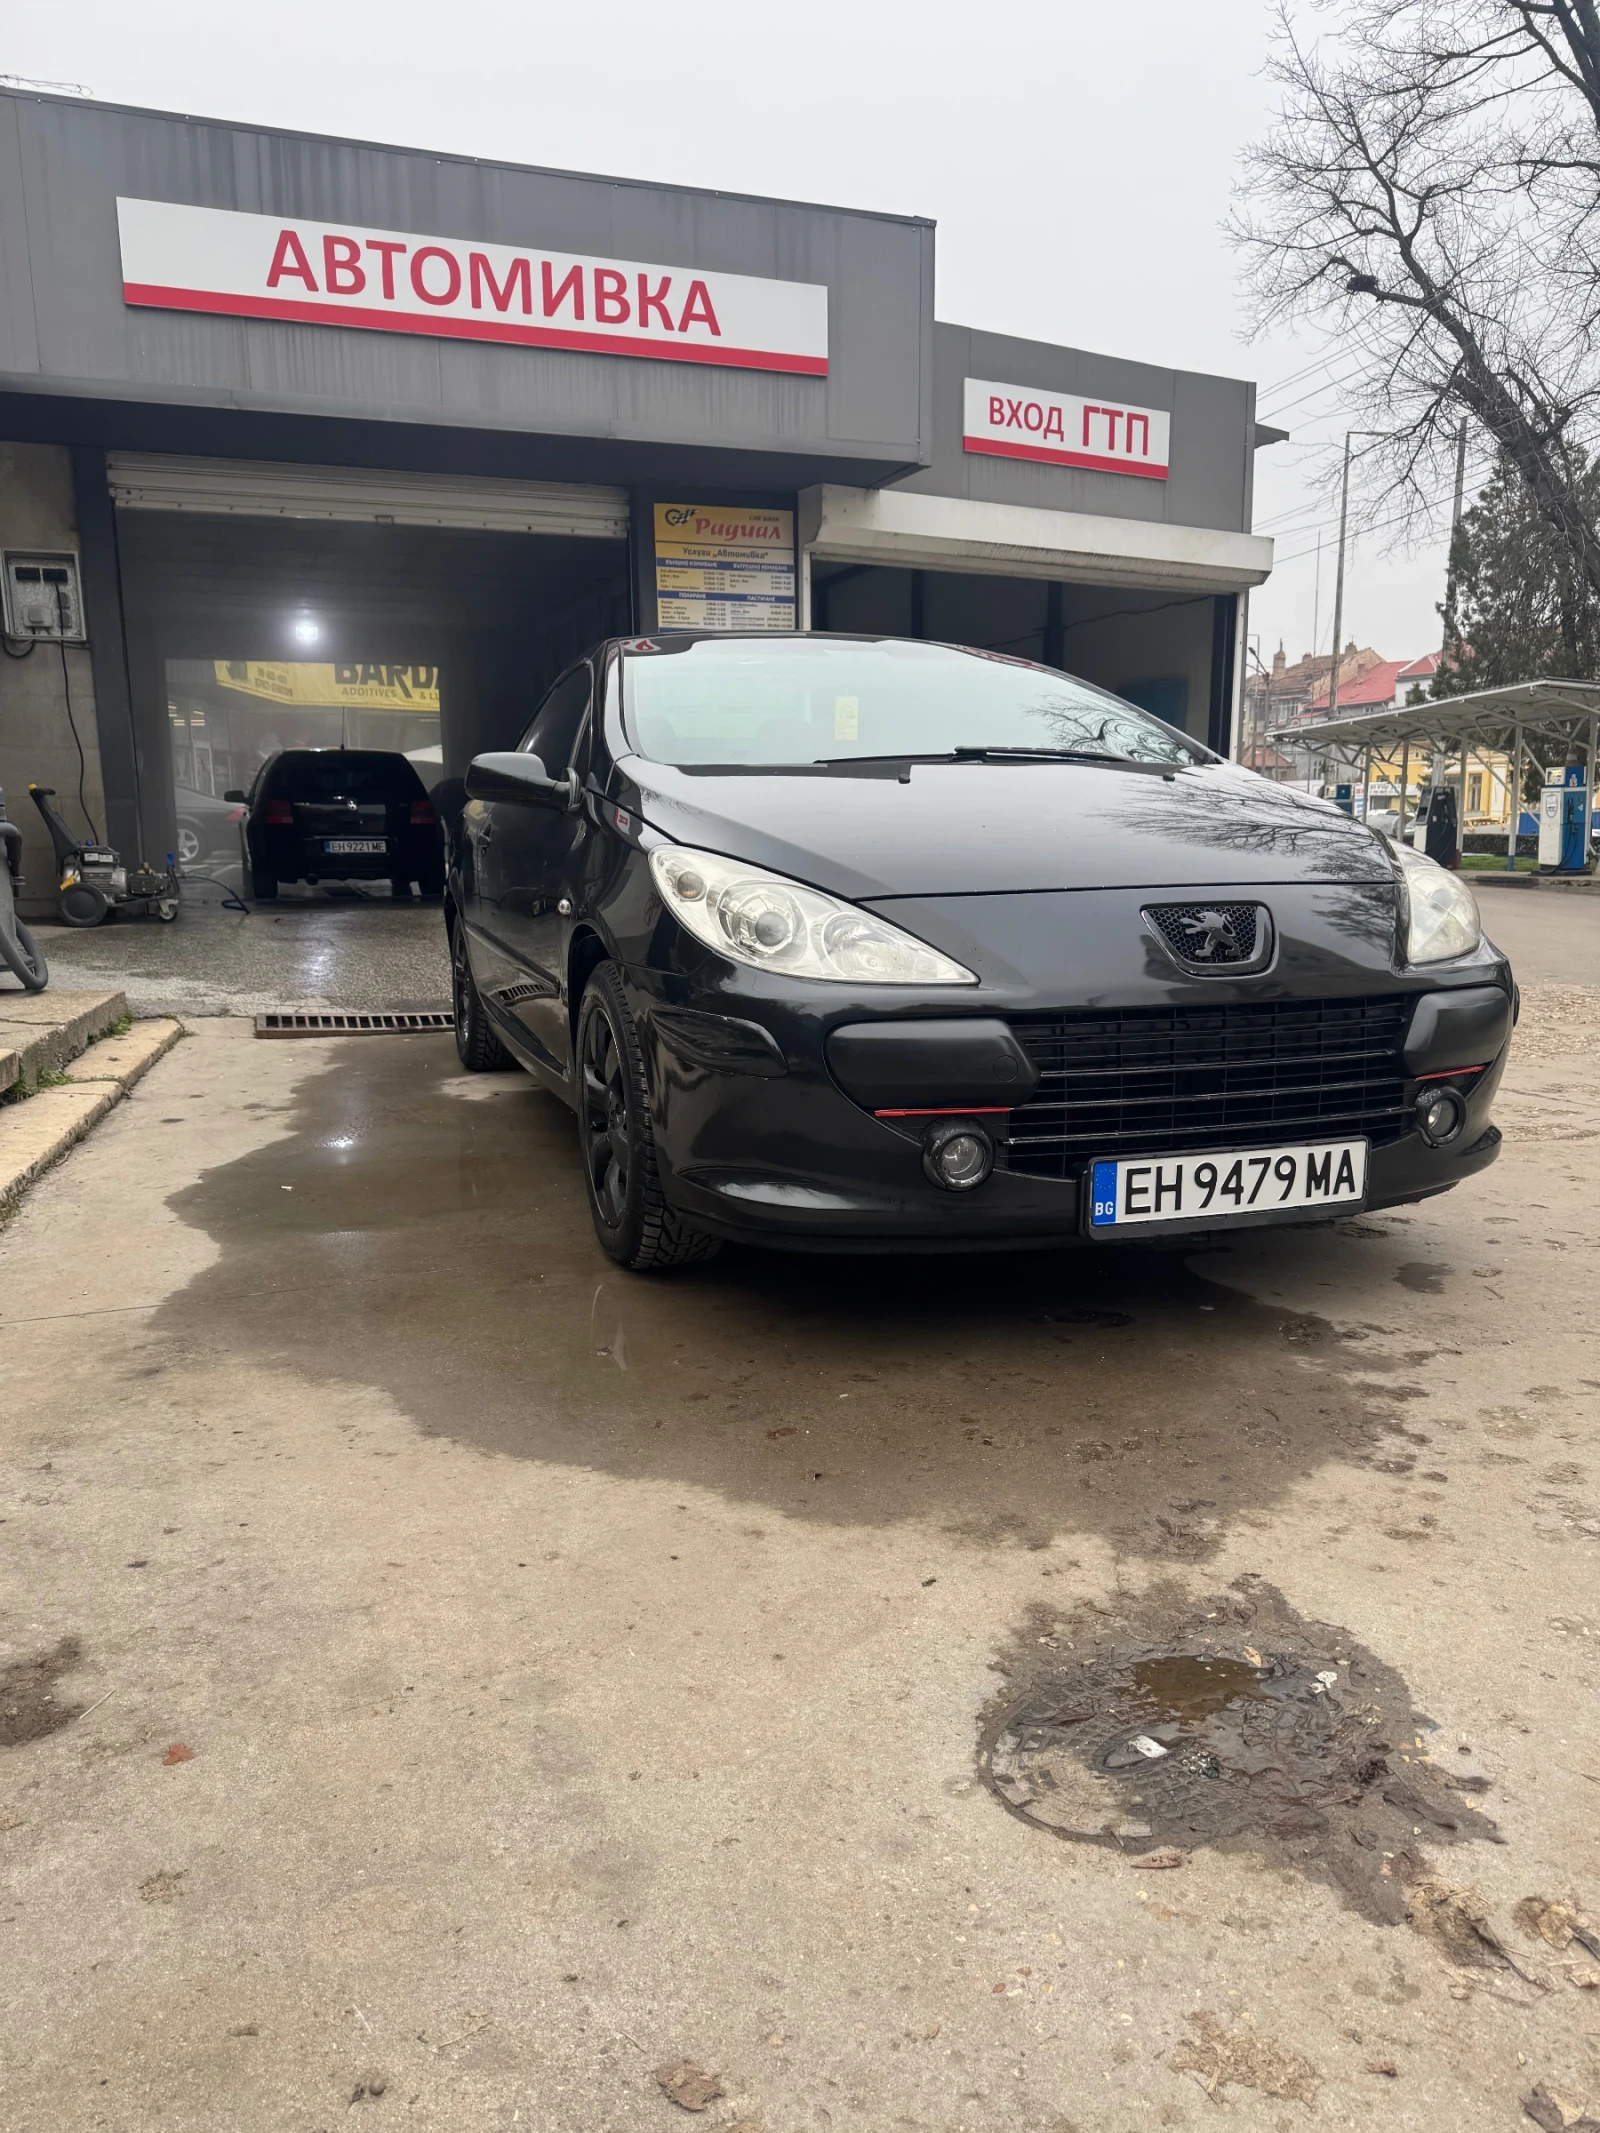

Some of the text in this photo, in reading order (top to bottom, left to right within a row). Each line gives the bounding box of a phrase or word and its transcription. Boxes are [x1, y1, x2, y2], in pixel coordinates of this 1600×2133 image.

[266, 229, 722, 337] АВТОМИВКА
[989, 396, 1149, 456] ВХОД ГТП
[682, 547, 711, 558] Услуги
[334, 664, 439, 699] BARD
[341, 686, 397, 698] ADDITIVES
[419, 691, 426, 700] &
[331, 842, 385, 852] EH 9221 ME
[1124, 1148, 1356, 1216] EH 9479 MA
[1094, 1201, 1114, 1217] BG
